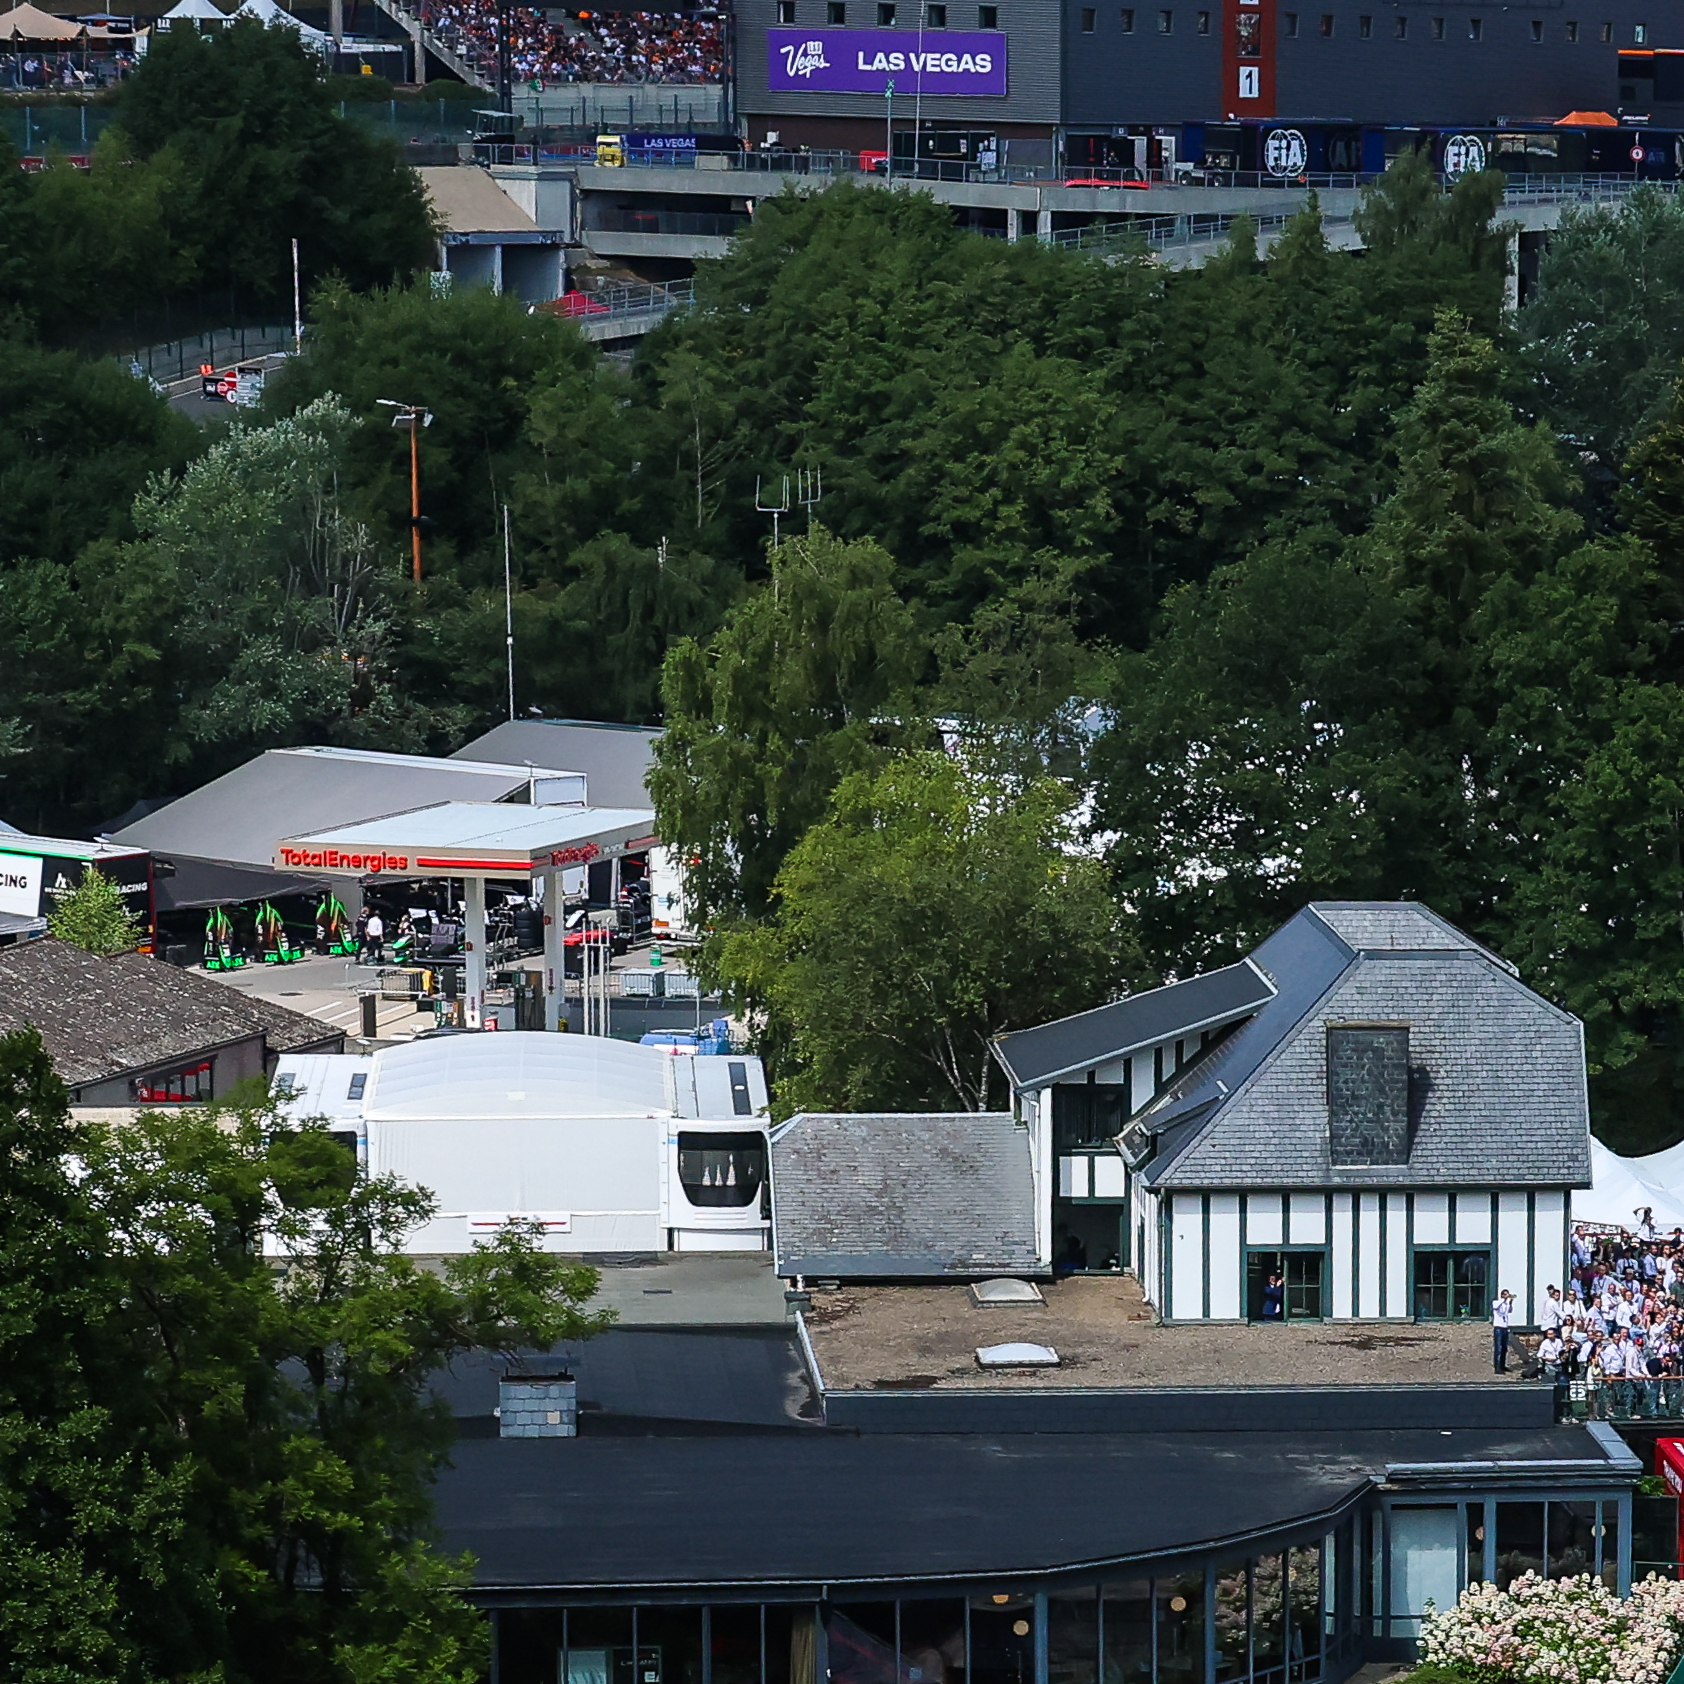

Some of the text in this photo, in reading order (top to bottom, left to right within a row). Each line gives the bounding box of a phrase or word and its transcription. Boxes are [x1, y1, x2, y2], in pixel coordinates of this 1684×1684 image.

[858, 51, 992, 73] LAS VEGAS
[1245, 70, 1253, 95] 1
[644, 138, 696, 148] LAS VEGAS
[280, 848, 408, 872] TotalEnergies
